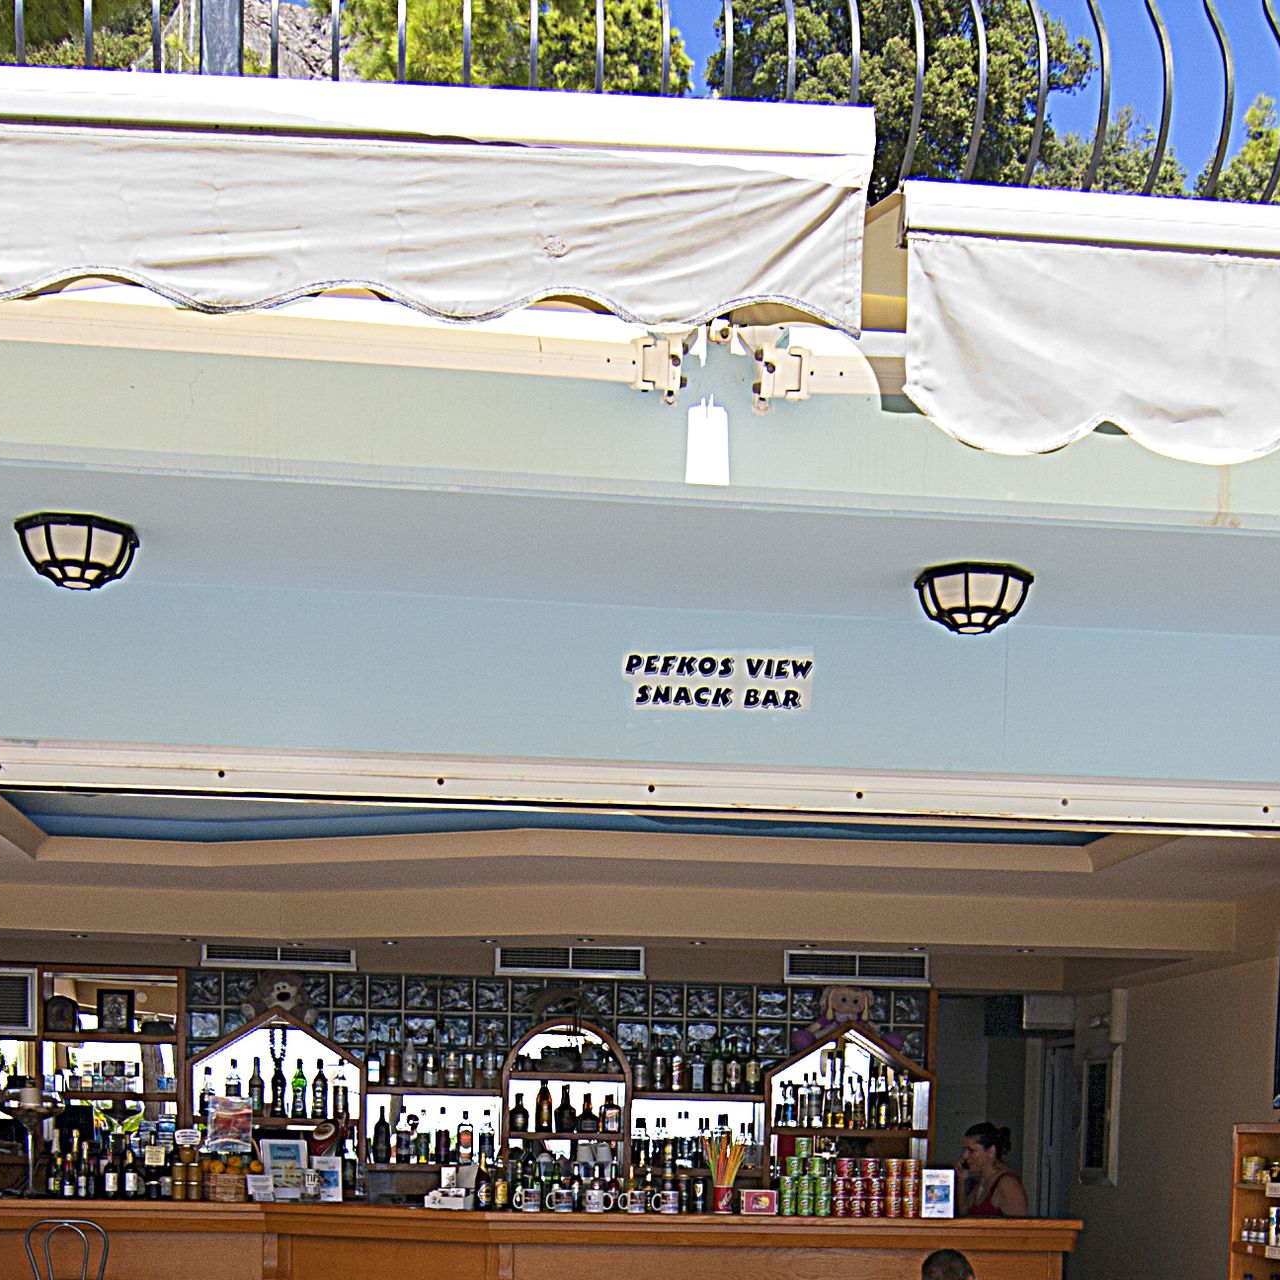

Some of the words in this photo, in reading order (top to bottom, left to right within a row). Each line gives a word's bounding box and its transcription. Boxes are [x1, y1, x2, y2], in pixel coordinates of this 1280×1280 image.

[625, 654, 735, 678] PEFKOS
[746, 658, 813, 679] VIEW
[635, 685, 733, 707] SNACK
[744, 689, 802, 709] BAR
